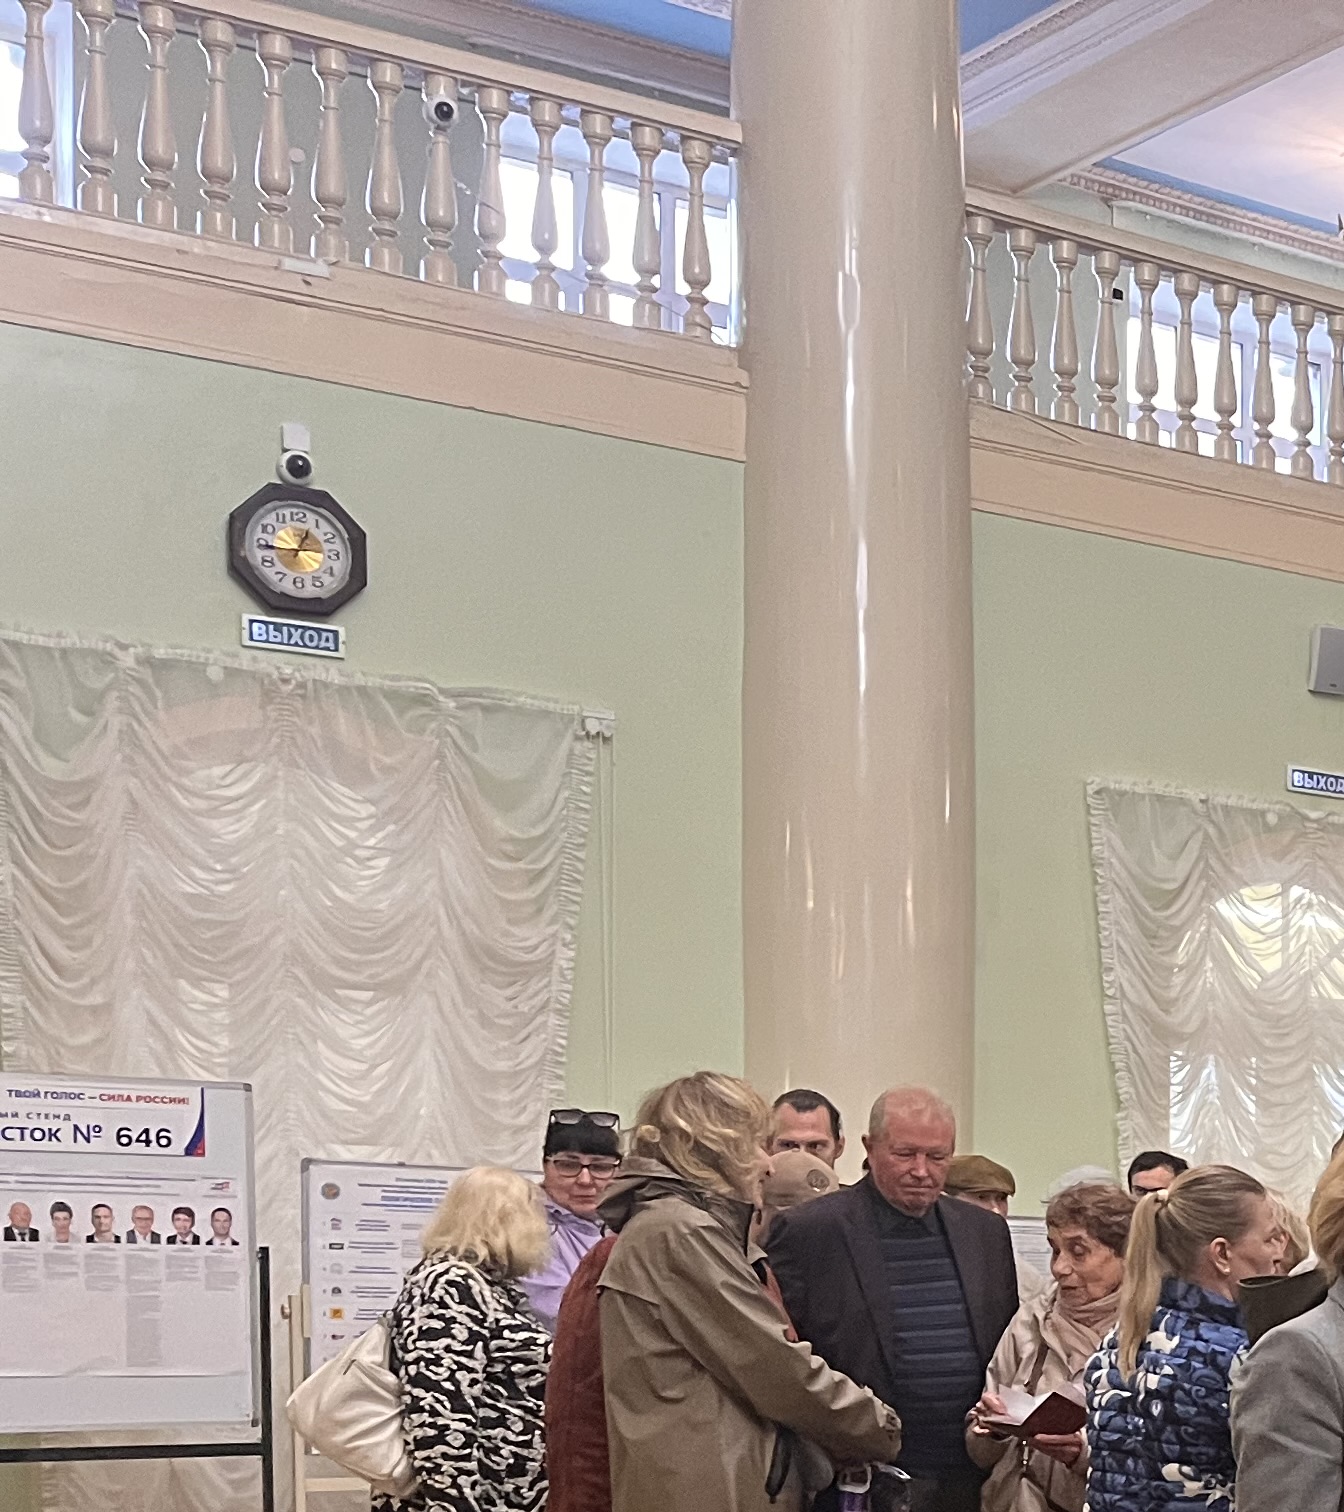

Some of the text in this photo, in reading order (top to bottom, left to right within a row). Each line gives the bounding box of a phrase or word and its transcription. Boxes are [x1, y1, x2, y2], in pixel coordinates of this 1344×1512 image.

[252, 622, 335, 650] ВЫХОД
[6, 1088, 41, 1099] ТВОЙ
[43, 1090, 85, 1101] ГОЛОС
[99, 1093, 133, 1103] СИЛА
[73, 1124, 103, 1144] №
[115, 1127, 172, 1148] 646
